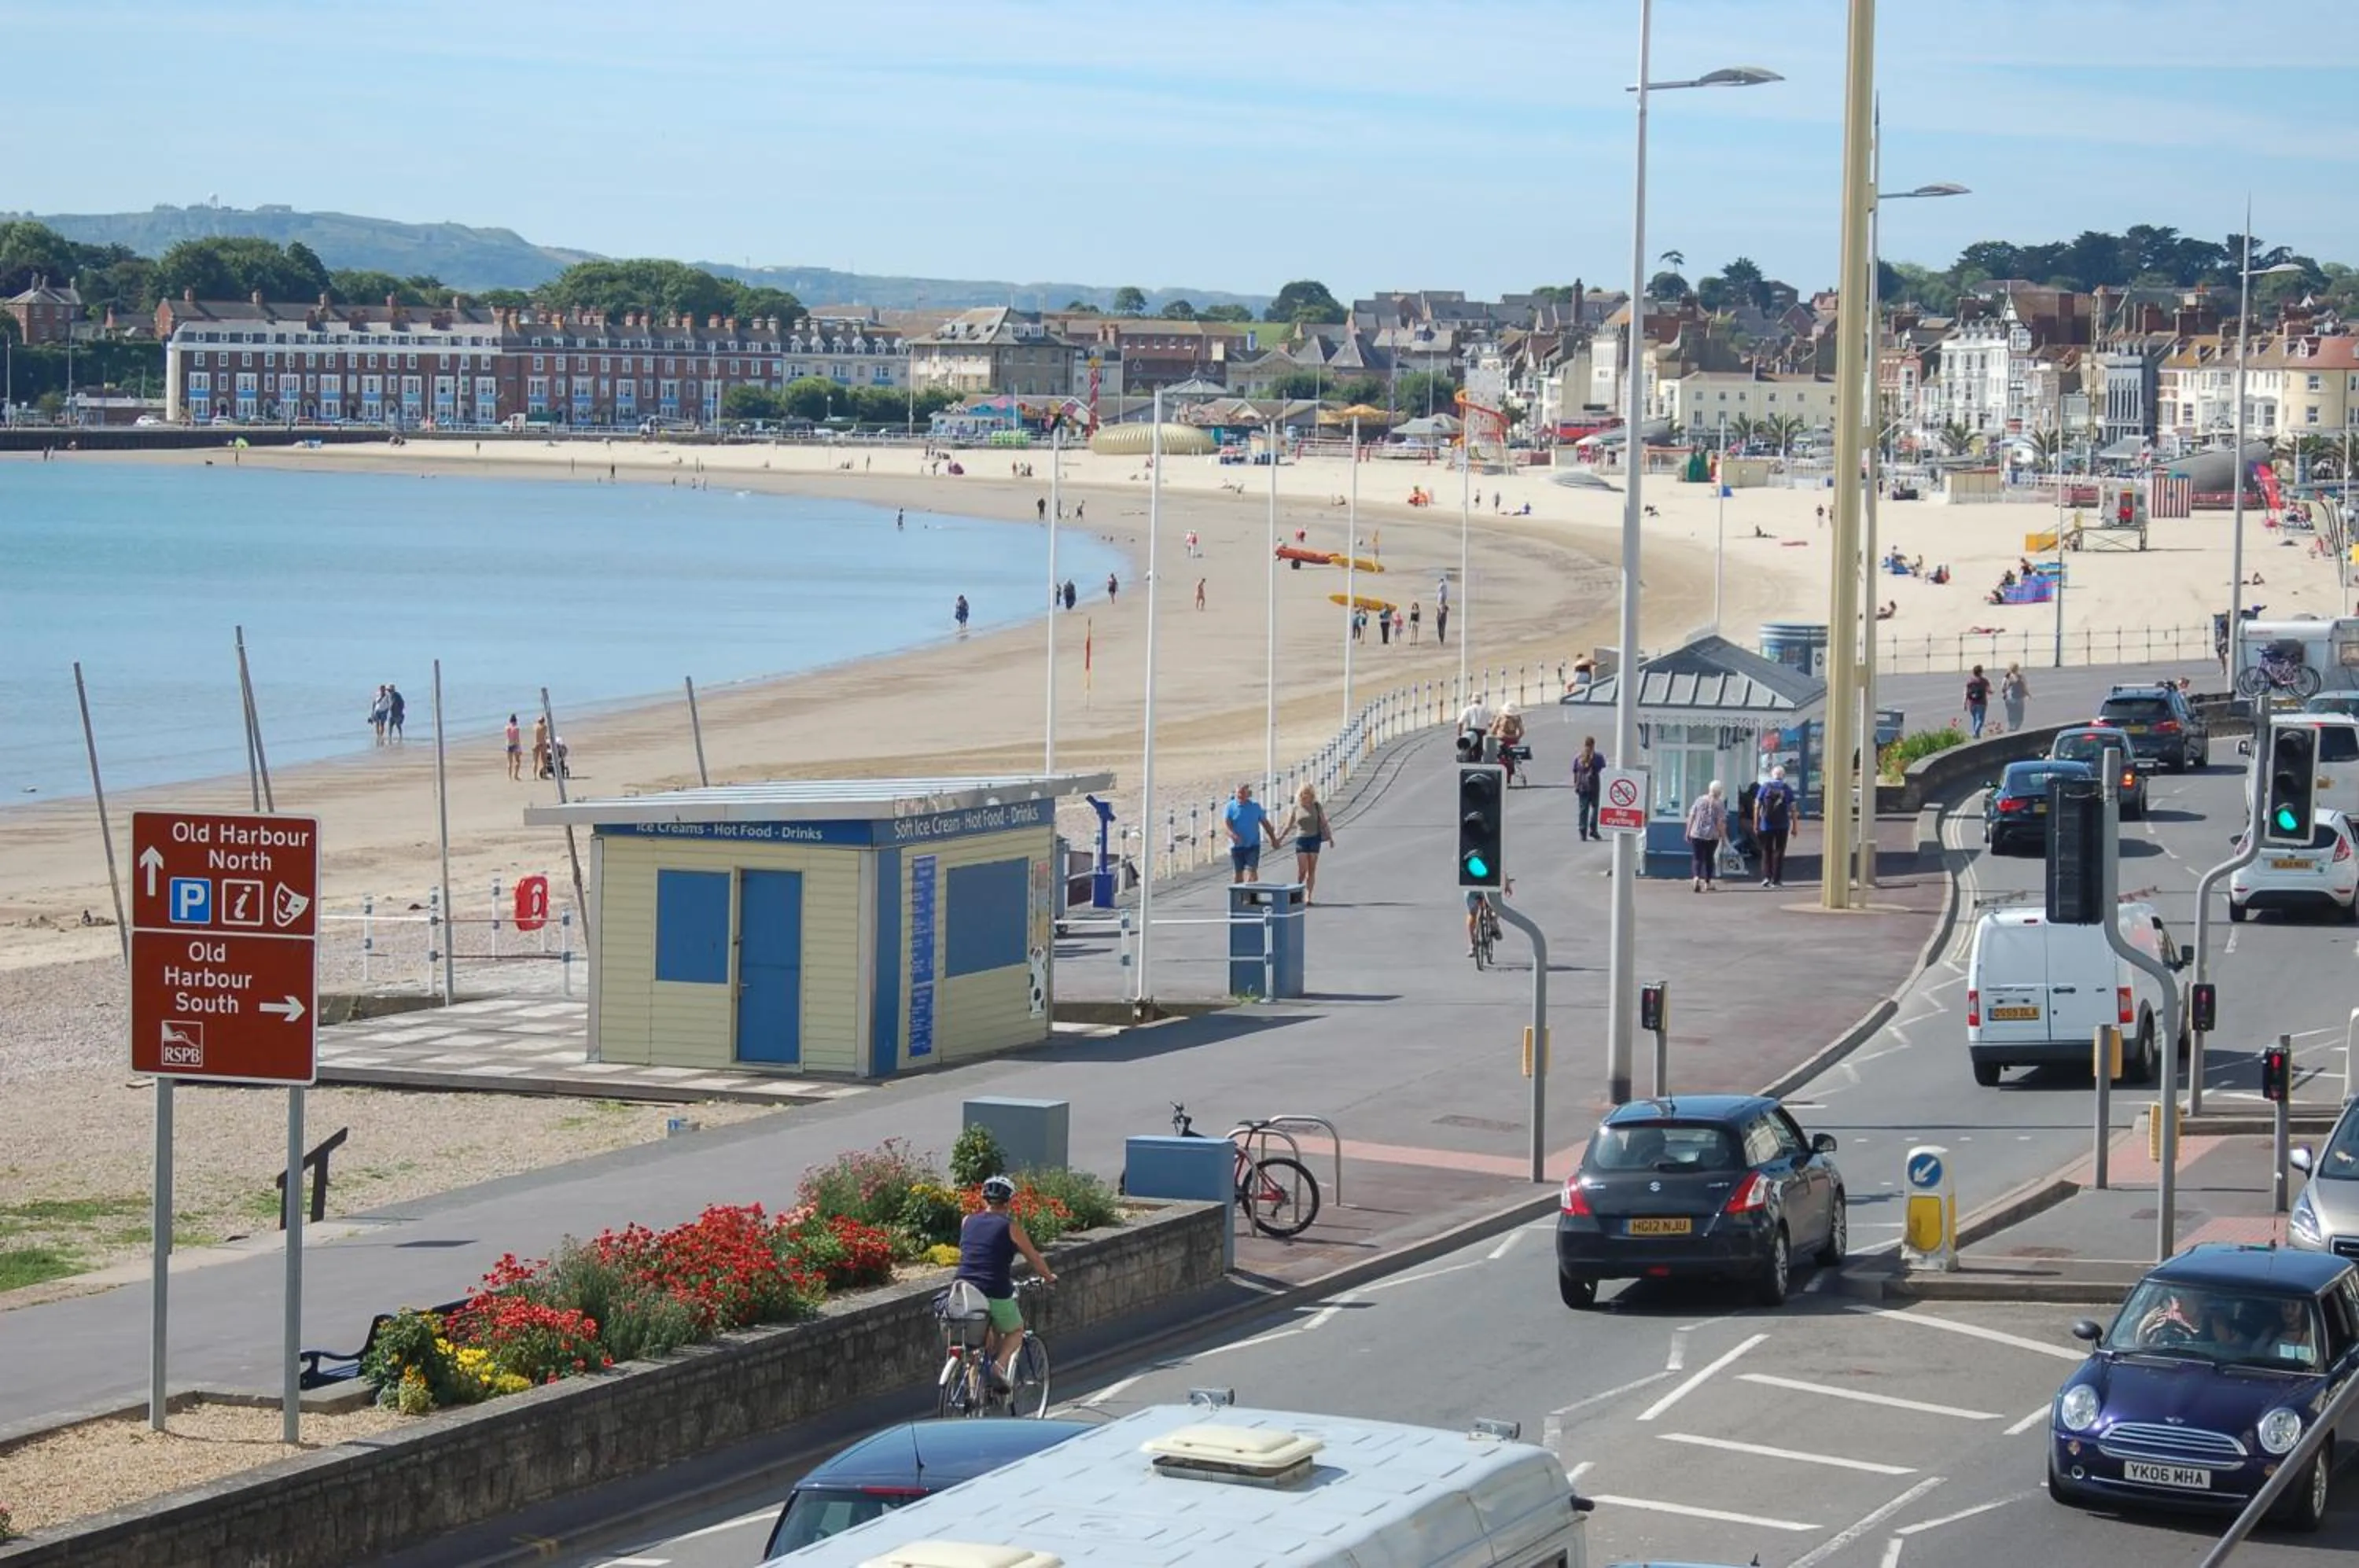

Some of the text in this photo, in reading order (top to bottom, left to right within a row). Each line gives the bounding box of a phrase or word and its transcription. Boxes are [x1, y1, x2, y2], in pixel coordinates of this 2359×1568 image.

[636, 822, 654, 833] Ice
[657, 822, 705, 835] Creams
[714, 826, 738, 836] Hot
[740, 826, 772, 838] Food
[782, 826, 823, 841] Drinks
[894, 818, 915, 839] Soft
[915, 819, 930, 837] Ice
[932, 815, 960, 834] Cream
[965, 811, 982, 830] Hot
[984, 807, 1005, 827] Food
[1010, 804, 1039, 824] Drinks
[172, 821, 309, 847] Old Harbour
[208, 849, 272, 871] North
[180, 882, 206, 918] P
[188, 942, 226, 963] Old
[164, 966, 252, 988] Harbour
[175, 992, 239, 1014] South
[164, 1047, 201, 1062] RSPB
[2131, 1464, 2204, 1485] YK06 MHA
